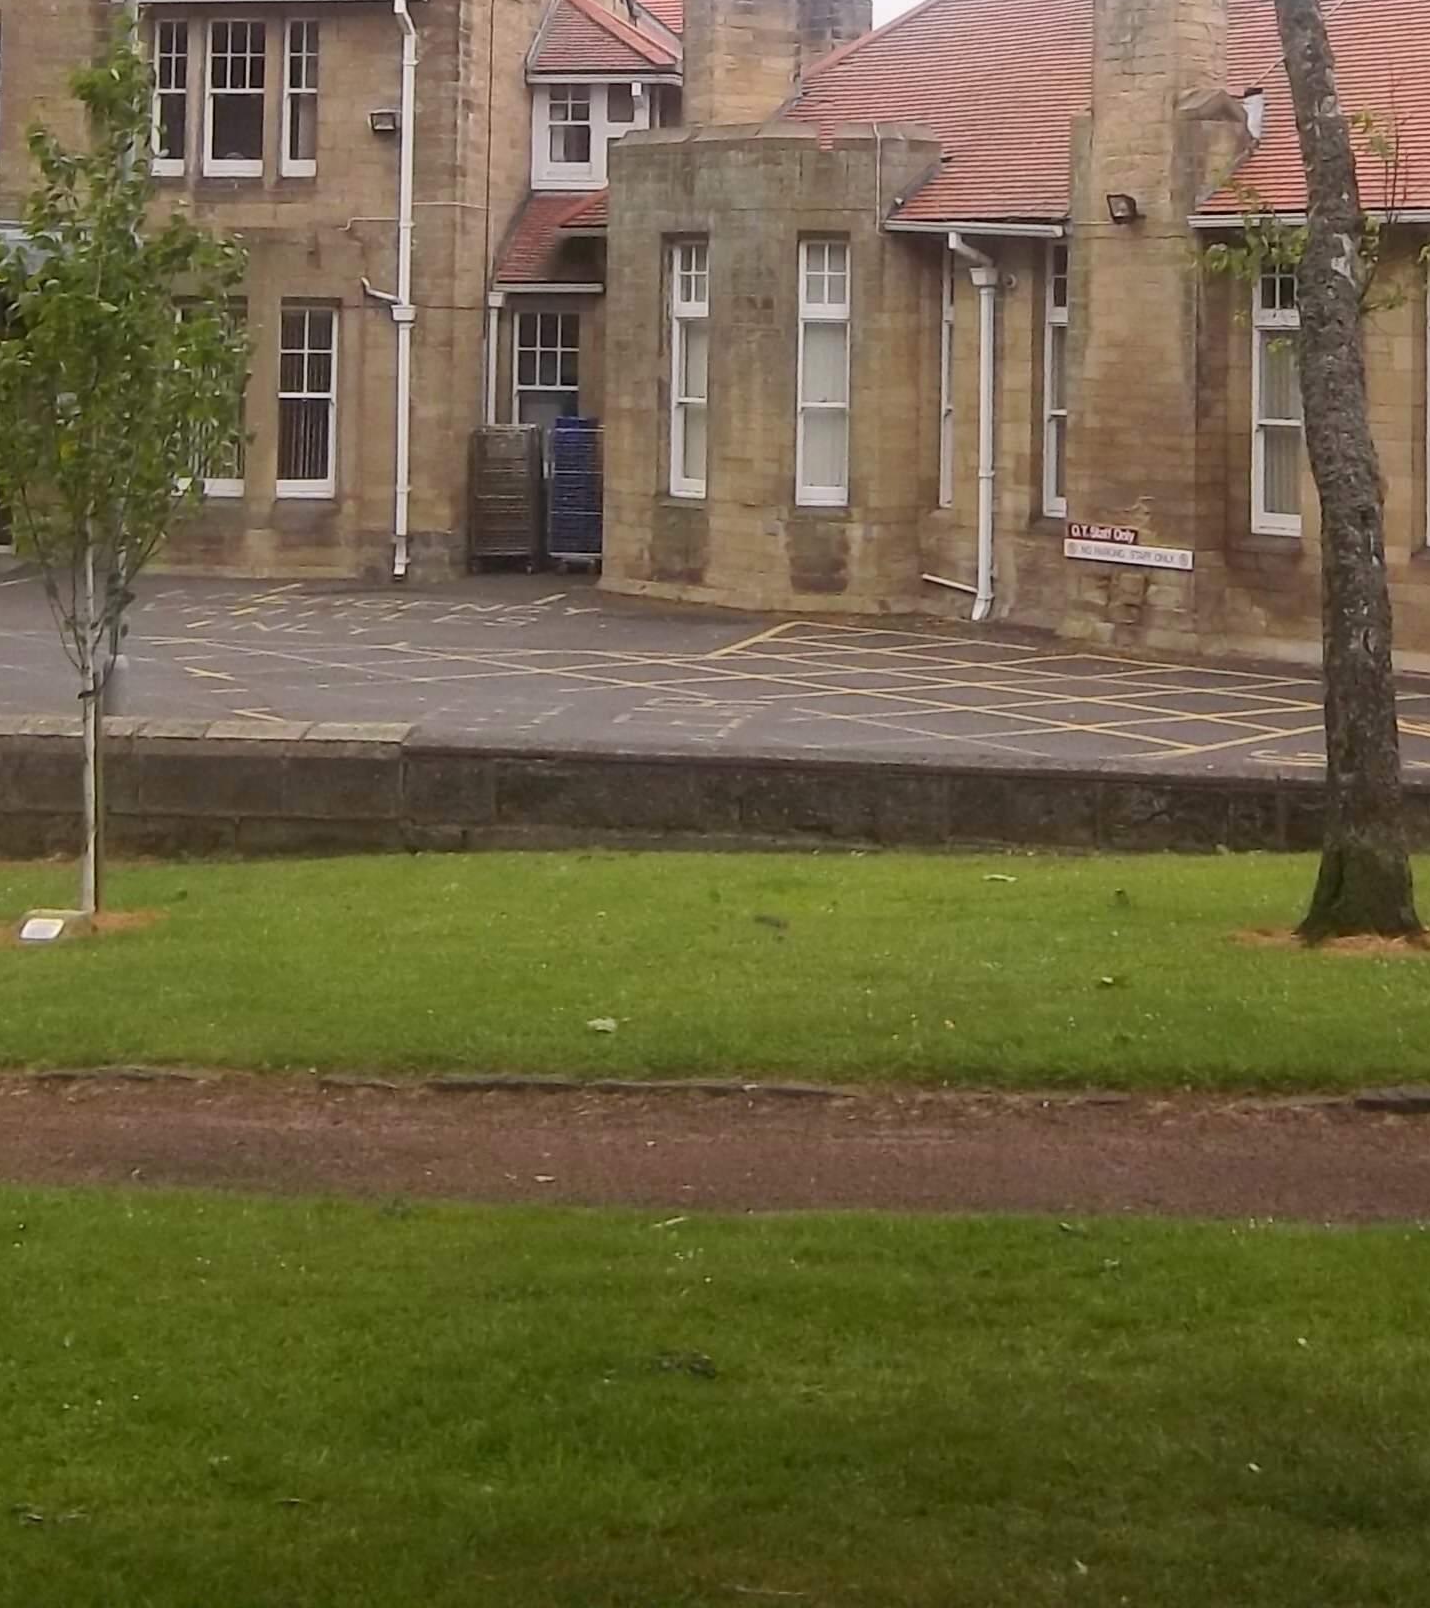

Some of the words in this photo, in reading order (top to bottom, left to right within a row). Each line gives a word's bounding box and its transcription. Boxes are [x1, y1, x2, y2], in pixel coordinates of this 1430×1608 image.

[1089, 526, 1112, 539] Staff
[1114, 527, 1135, 544] Only
[1155, 553, 1174, 563] ONLY
